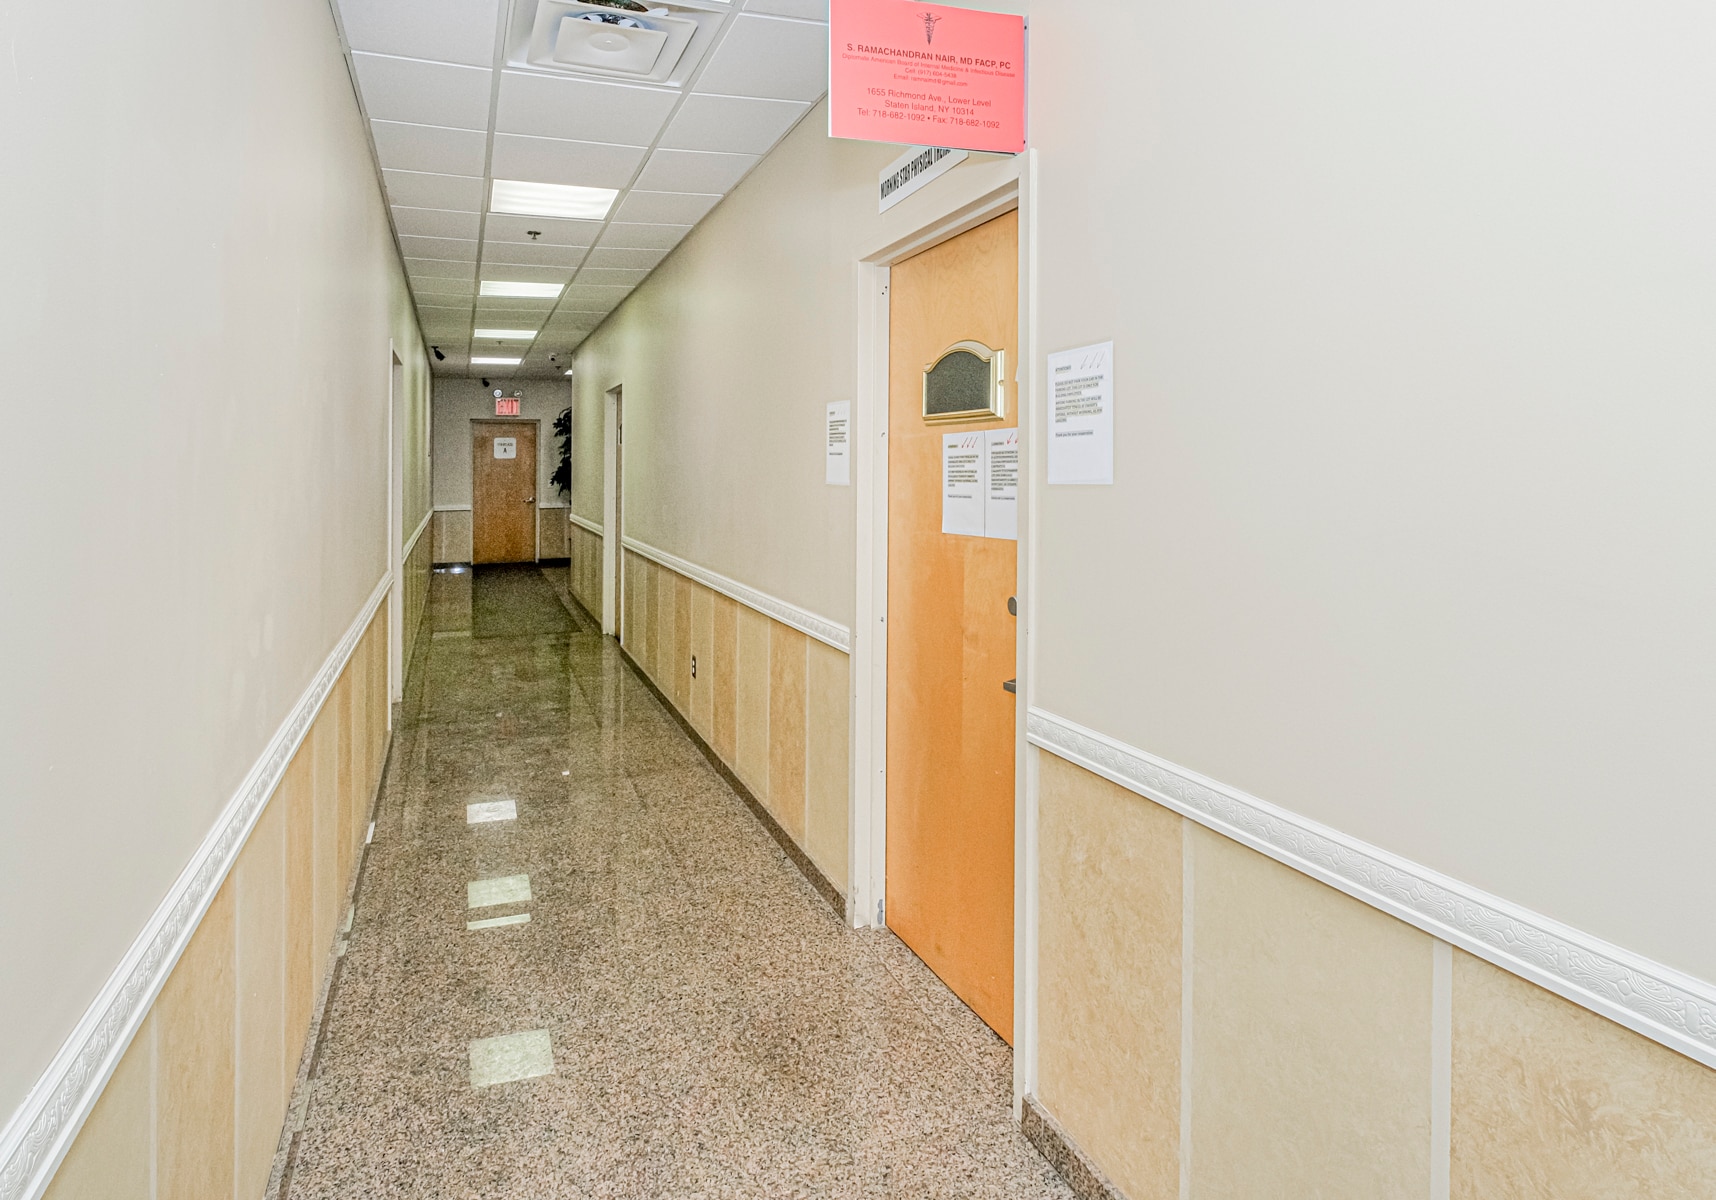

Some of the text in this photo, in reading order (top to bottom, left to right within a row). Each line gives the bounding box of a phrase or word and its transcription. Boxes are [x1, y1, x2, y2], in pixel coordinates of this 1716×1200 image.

[847, 43, 1011, 70] S. RAMACHANDRAN NAIR, MD FACP, PC
[871, 56, 896, 64] American
[941, 64, 963, 72] Medicine
[970, 68, 994, 76] Infectious
[995, 70, 1015, 78] Disease
[918, 69, 931, 77] (917)
[868, 88, 886, 97] 1655
[888, 89, 926, 100] Richmond
[948, 96, 970, 105] Lower
[972, 98, 991, 107] Level
[884, 100, 974, 115] Staten Island, NY 10314
[872, 109, 925, 122] 718-682-1092
[949, 117, 1000, 128] 718-682-1092
[899, 163, 911, 187] STAR
[911, 147, 933, 179] PHYSICAL
[497, 399, 519, 414] EXIT
